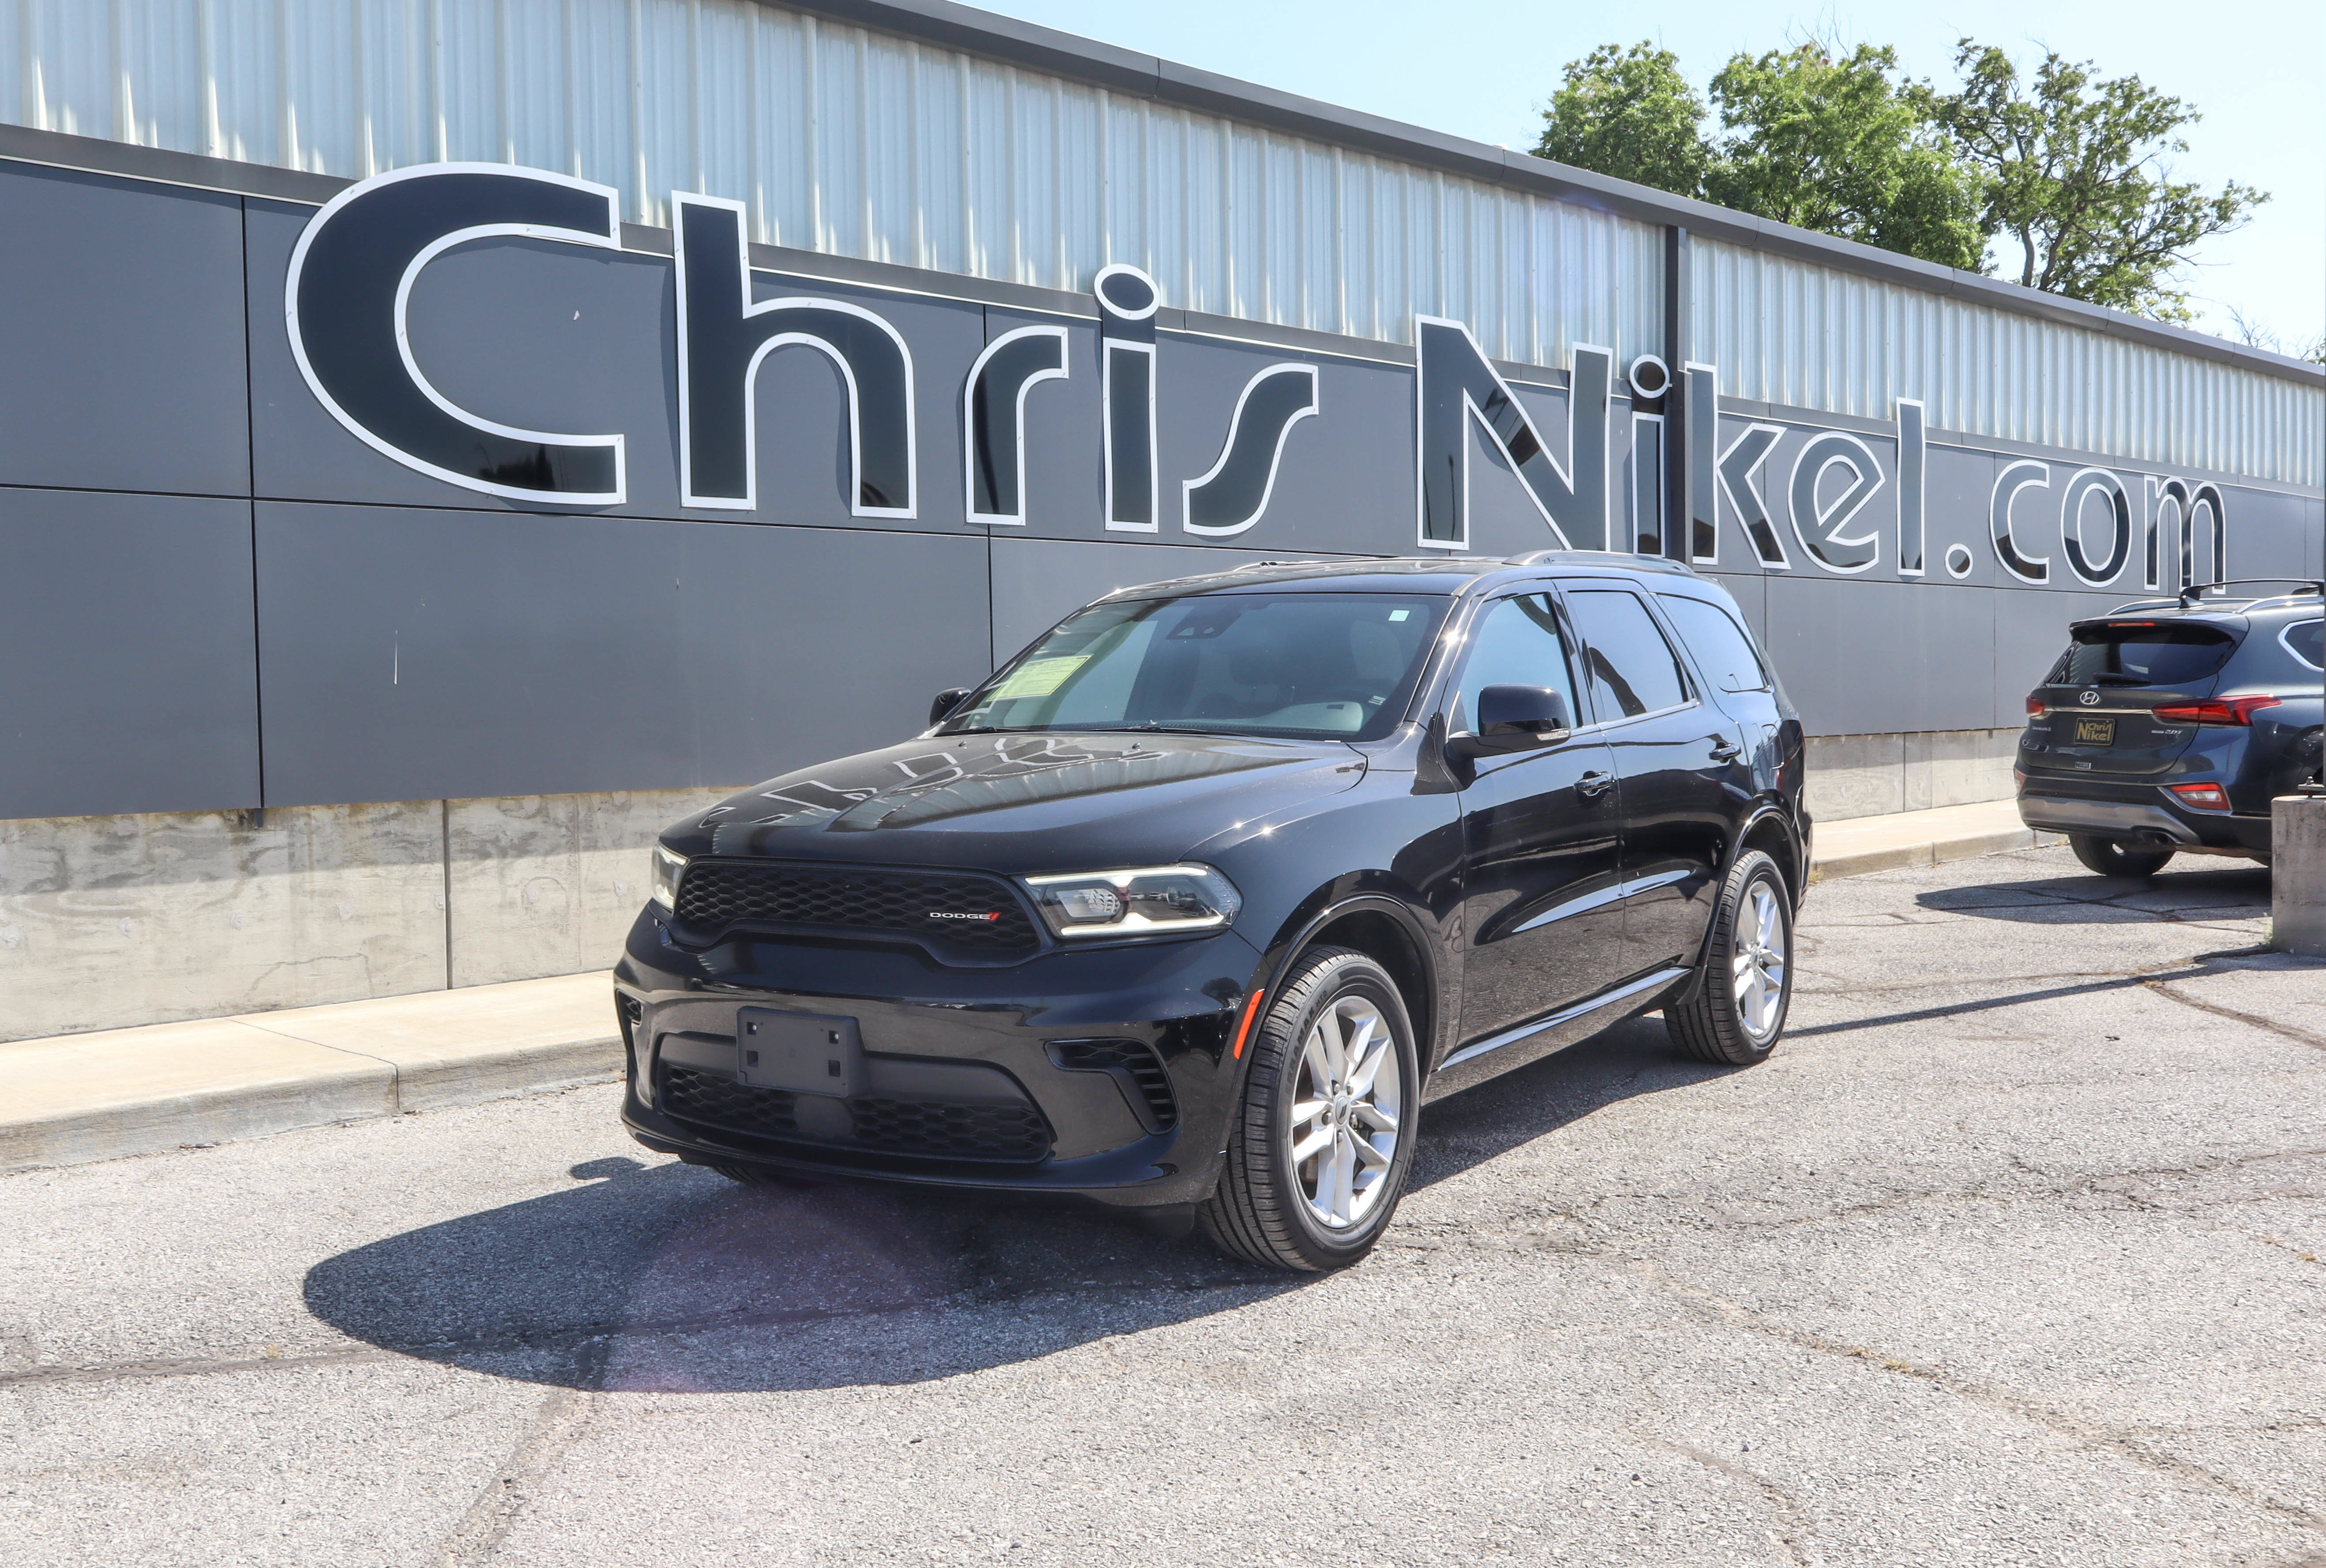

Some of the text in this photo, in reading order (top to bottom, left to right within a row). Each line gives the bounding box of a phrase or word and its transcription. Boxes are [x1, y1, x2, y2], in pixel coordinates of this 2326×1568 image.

[284, 161, 2227, 596] Chris Nikel.com
[2076, 722, 2112, 742] Nikel
[2087, 722, 2110, 731] Chris
